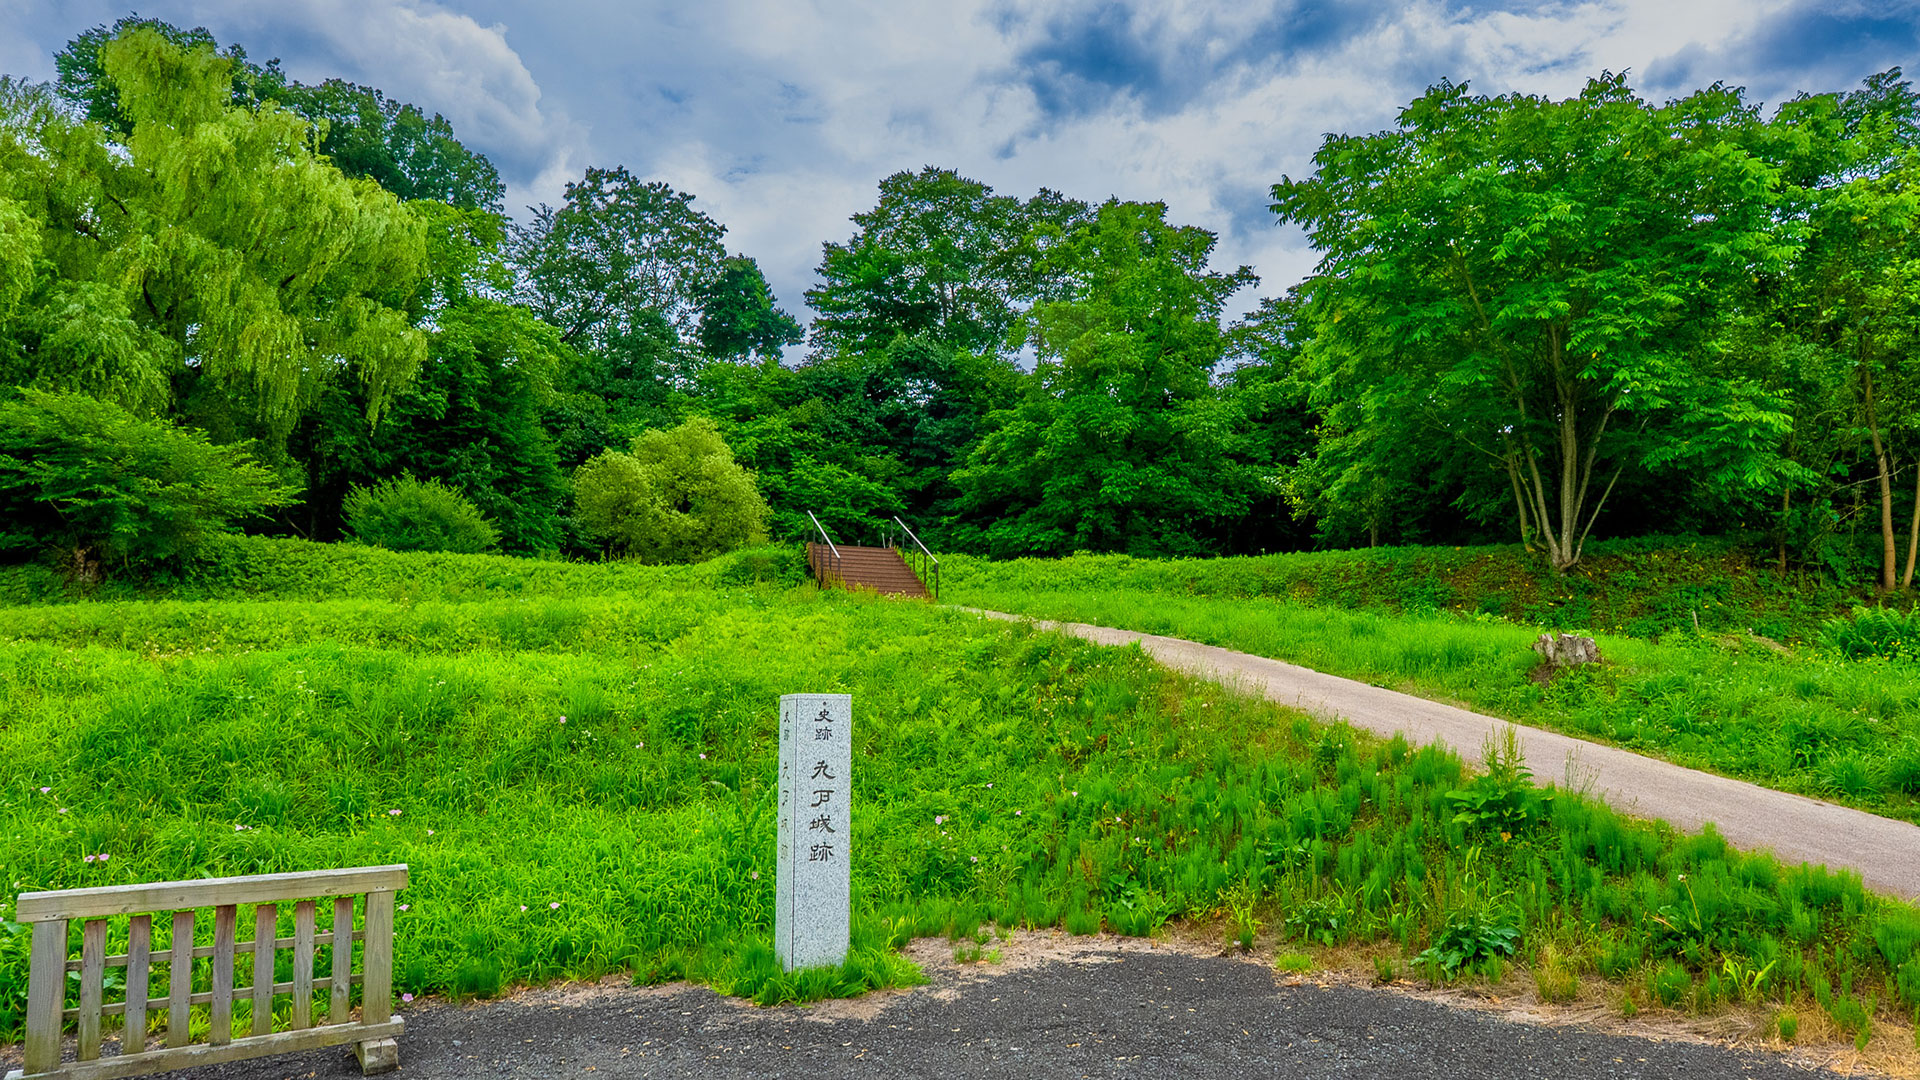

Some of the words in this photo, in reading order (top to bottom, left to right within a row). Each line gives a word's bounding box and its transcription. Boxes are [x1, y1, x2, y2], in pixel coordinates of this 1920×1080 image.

[814, 708, 834, 741] 史跡
[809, 760, 836, 863] 九戸城跡
